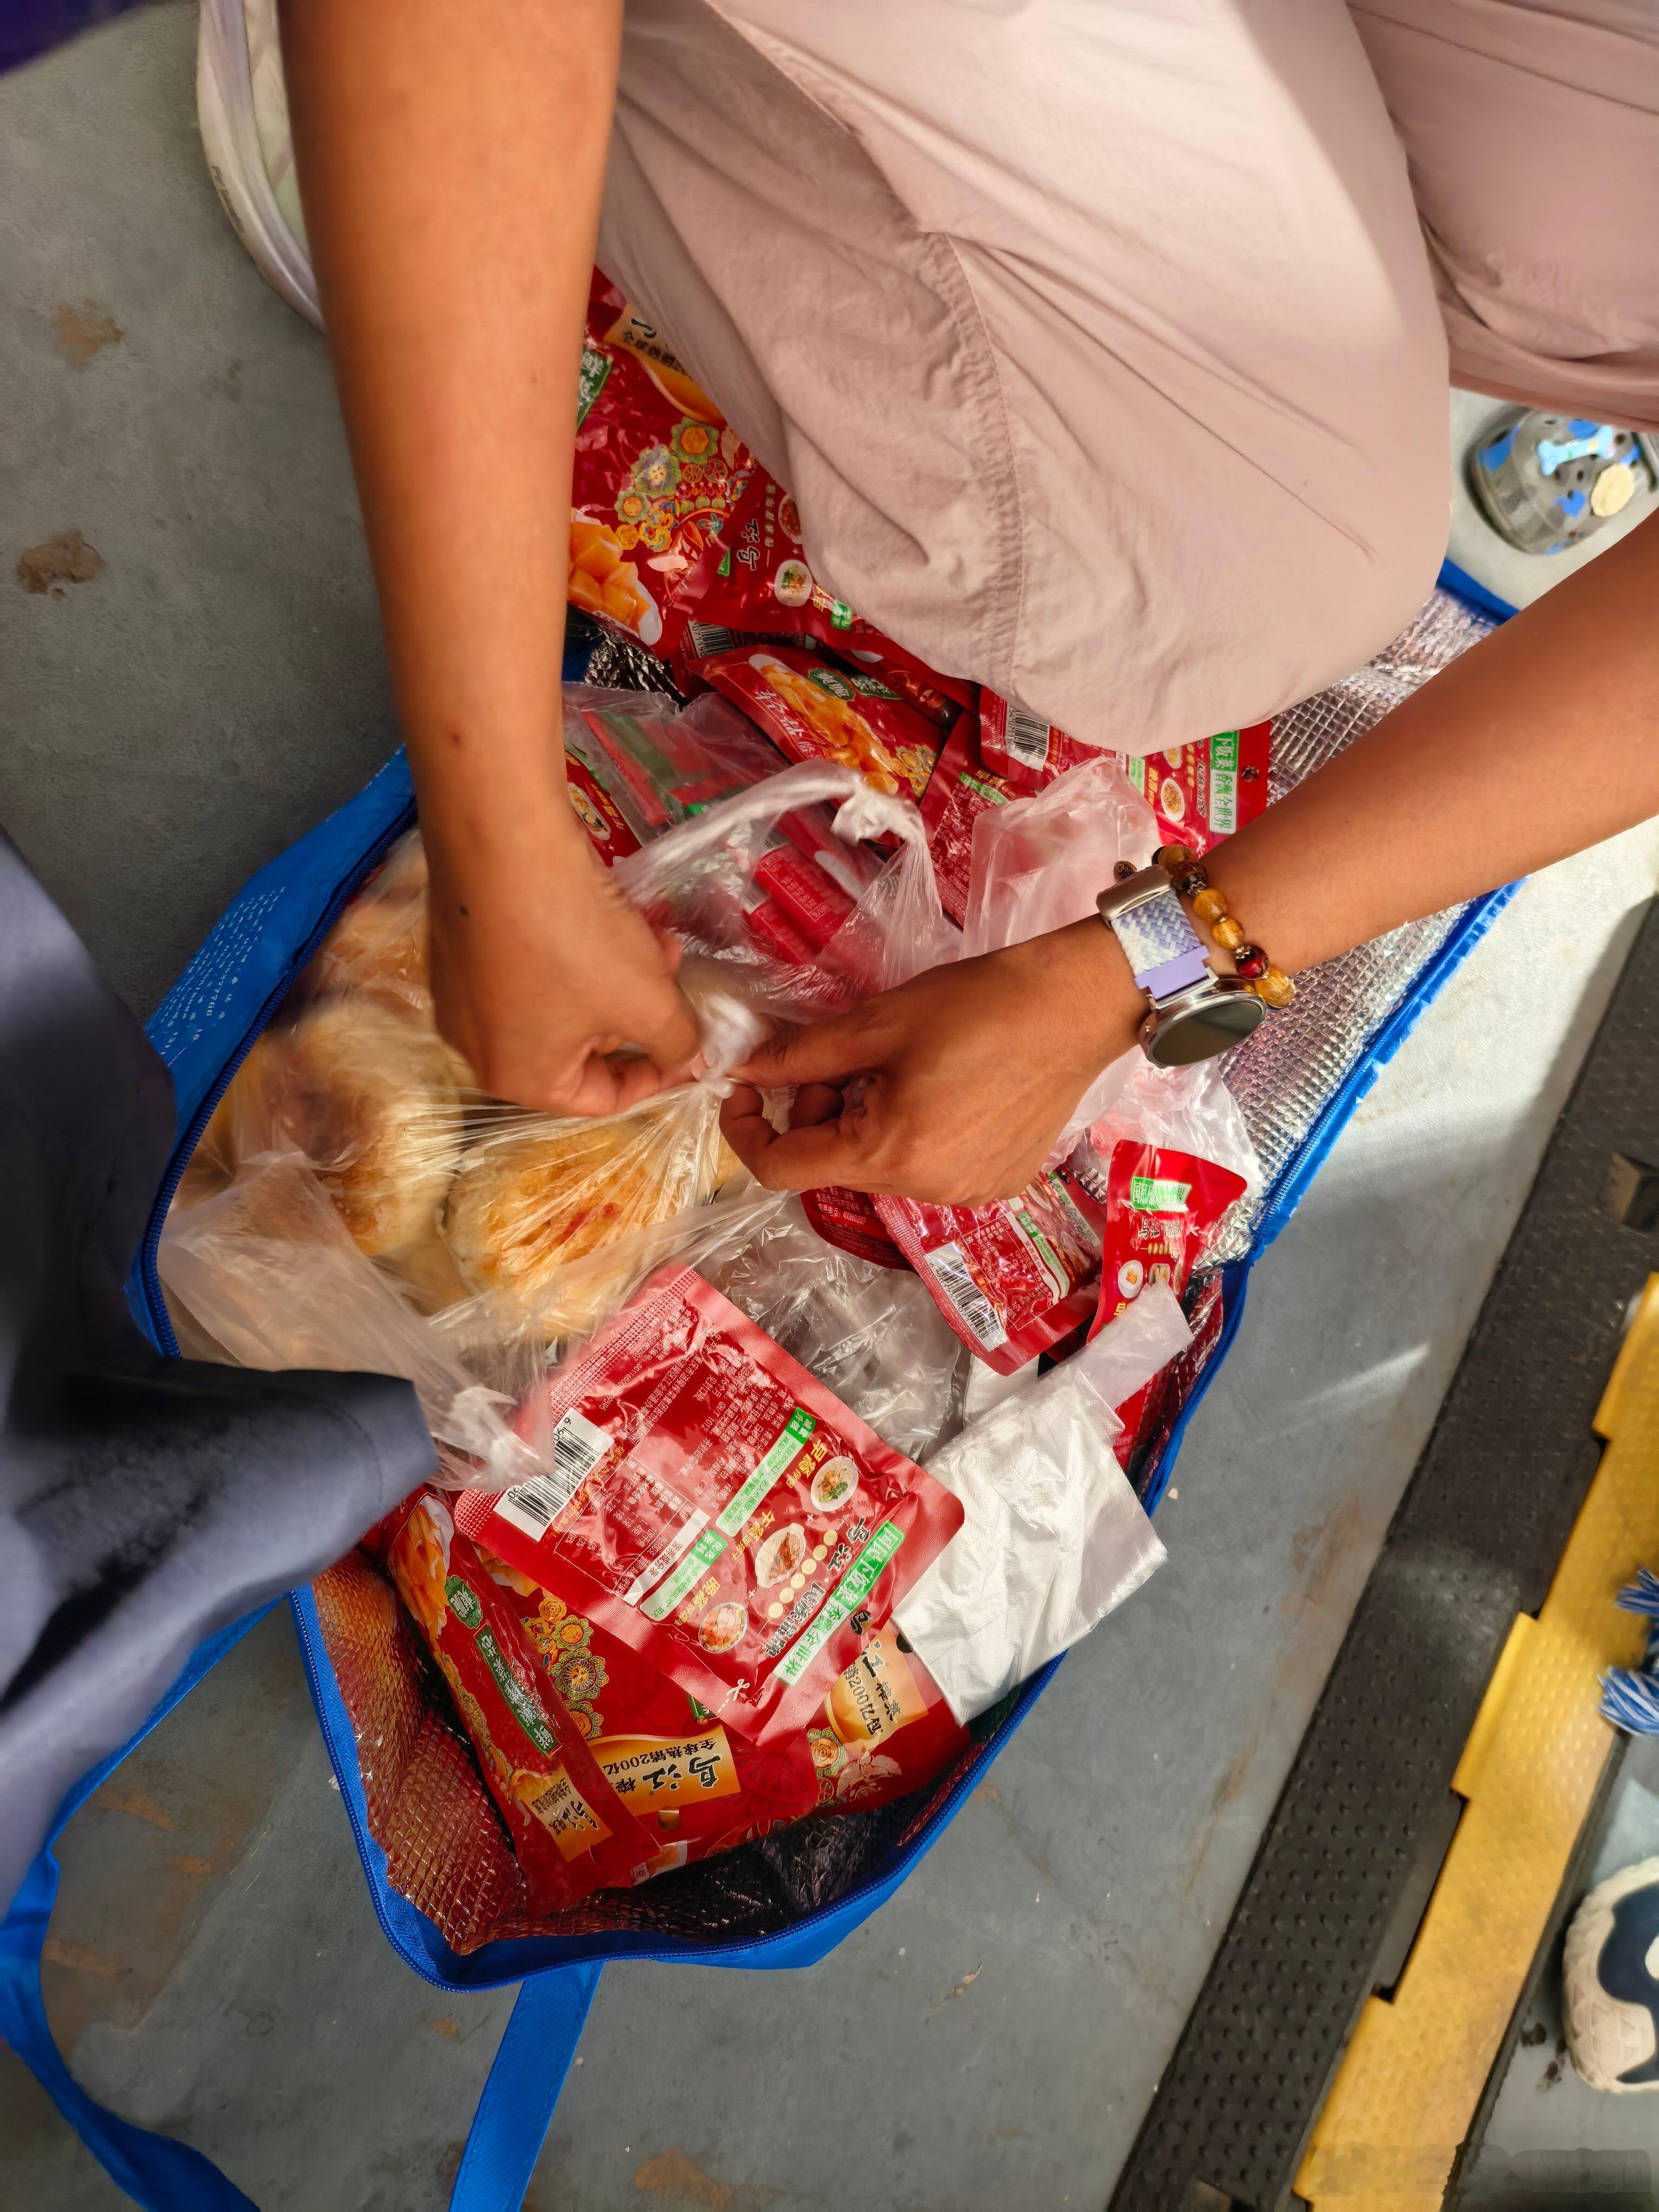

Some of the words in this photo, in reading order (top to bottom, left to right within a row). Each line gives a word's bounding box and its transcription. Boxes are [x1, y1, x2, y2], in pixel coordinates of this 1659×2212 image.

[700, 1415, 716, 1432] 1012
[784, 1438, 830, 1492] 早餐伴侣
[626, 1473, 655, 1506] 碳水化合物
[603, 1495, 621, 1513] 3.2克
[622, 1510, 639, 1528] 1.1克
[631, 1518, 648, 1536] 1.4克
[575, 1535, 588, 1548] 13%
[646, 1534, 667, 1557] 每100克
[696, 1533, 714, 1555] 原料
[704, 1540, 723, 1561] 优选
[647, 1539, 683, 1578] 营养成分表
[833, 1526, 899, 1607] 国民下饭菜
[779, 1598, 846, 1678] 香飘全世界
[874, 1680, 902, 1721] 榨菜
[602, 1737, 716, 1775] 全球热销200亿
[640, 1753, 724, 1797] 乌江
